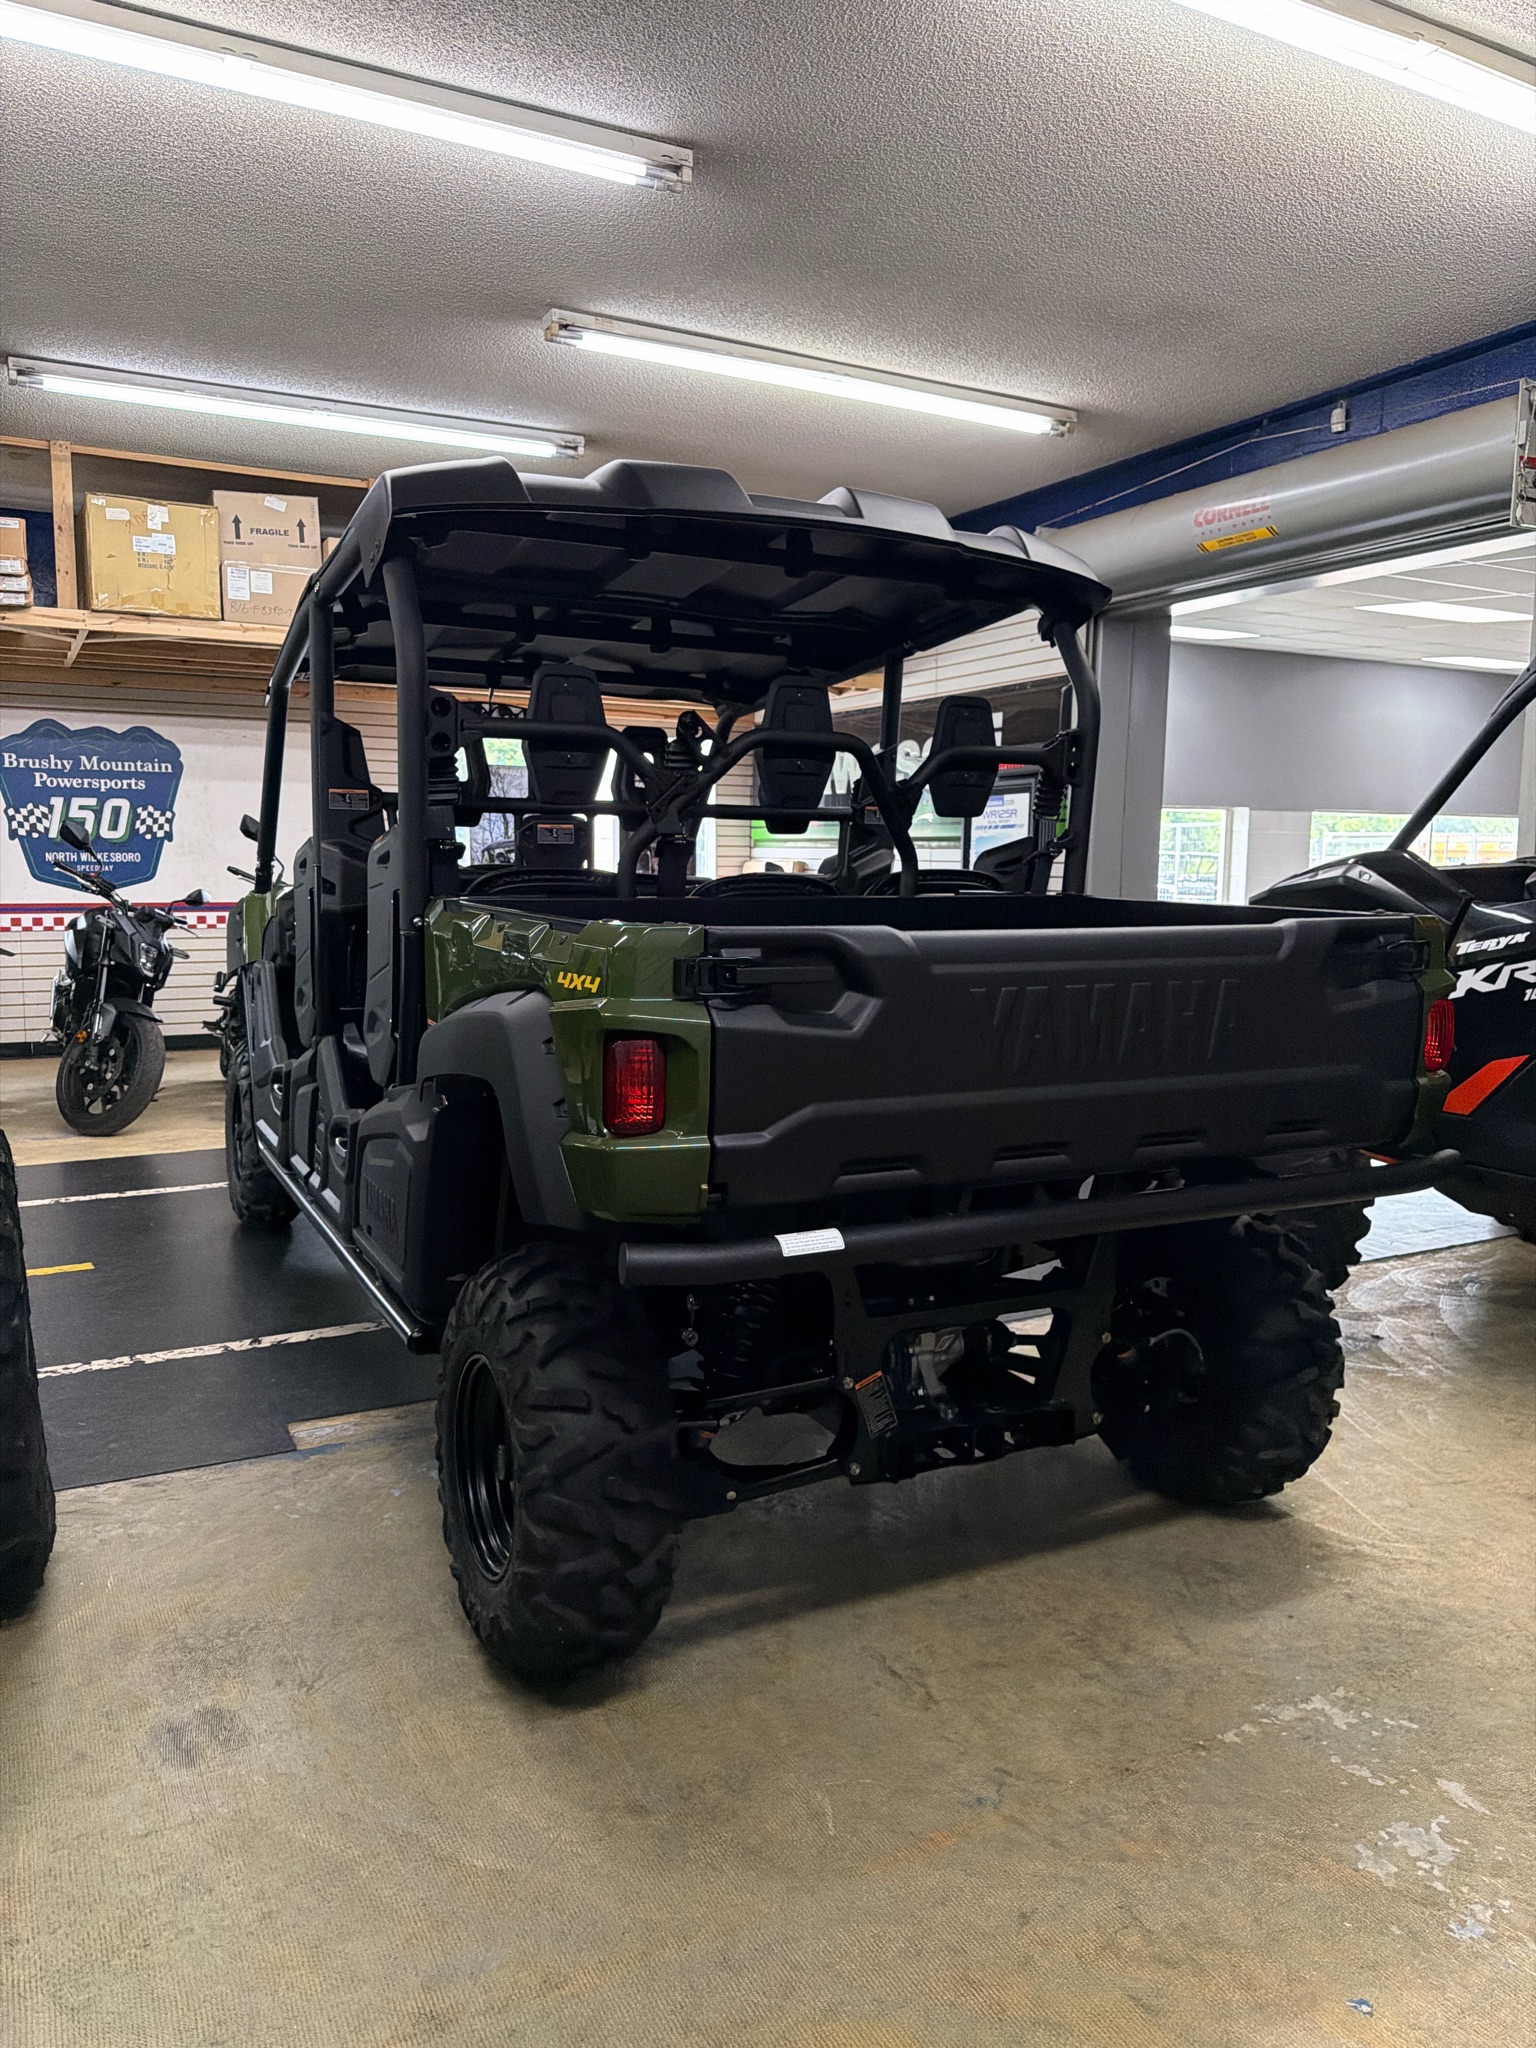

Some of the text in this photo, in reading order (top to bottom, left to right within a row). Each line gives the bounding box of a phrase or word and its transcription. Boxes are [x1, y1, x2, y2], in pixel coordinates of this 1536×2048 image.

[249, 527, 290, 537] FRAGILE
[2, 752, 174, 773] Brushy Mountain
[33, 772, 146, 792] Powersports
[48, 797, 131, 840] 150
[45, 852, 78, 863] NORTH
[76, 864, 114, 872] SPEEDAY
[968, 978, 1242, 1073] YAMAHA
